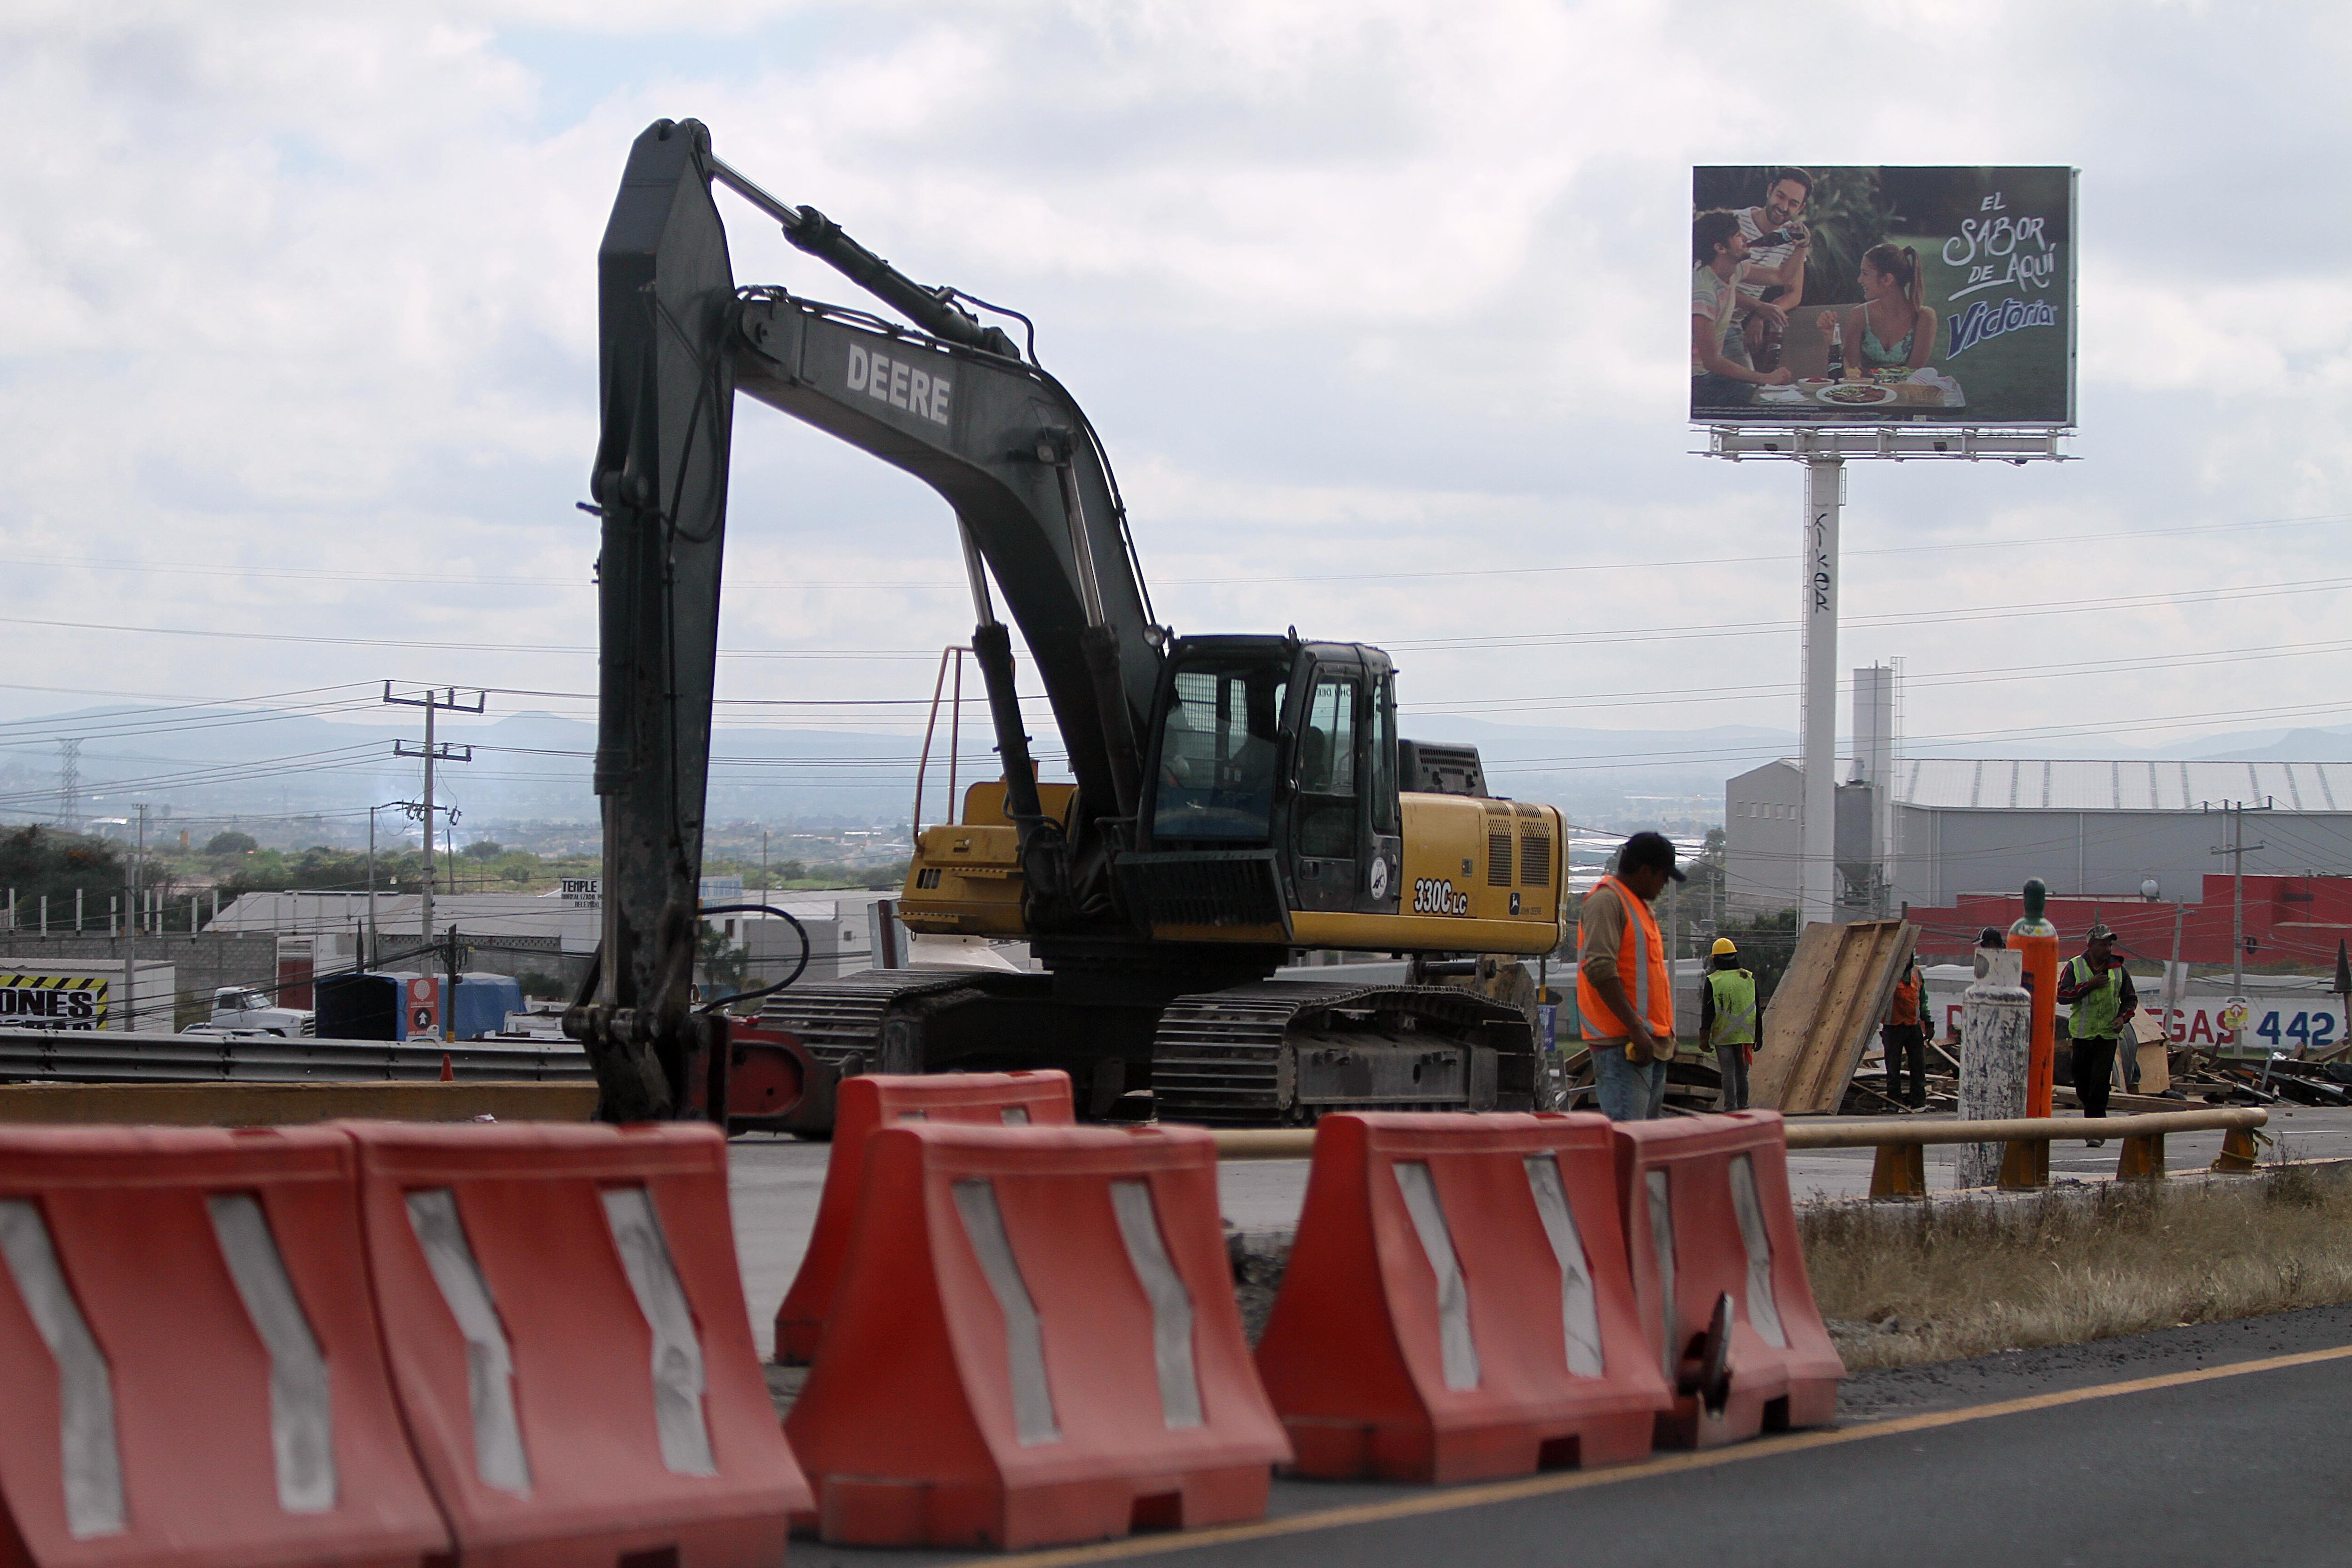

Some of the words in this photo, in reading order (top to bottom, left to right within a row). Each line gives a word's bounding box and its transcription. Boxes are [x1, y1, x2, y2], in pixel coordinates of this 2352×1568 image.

[1980, 191, 2006, 211] EL
[1942, 216, 2046, 266] SABOR
[1968, 264, 1994, 283] DE
[2006, 242, 2056, 293] AQUÍ
[1946, 297, 2055, 360] Victoria
[847, 343, 951, 425] DEERE
[562, 881, 596, 892] TEMPLE
[1414, 878, 1452, 913] 330C
[1452, 894, 1467, 915] LC
[0, 989, 93, 1018] ONES
[2256, 1011, 2335, 1045] 442
